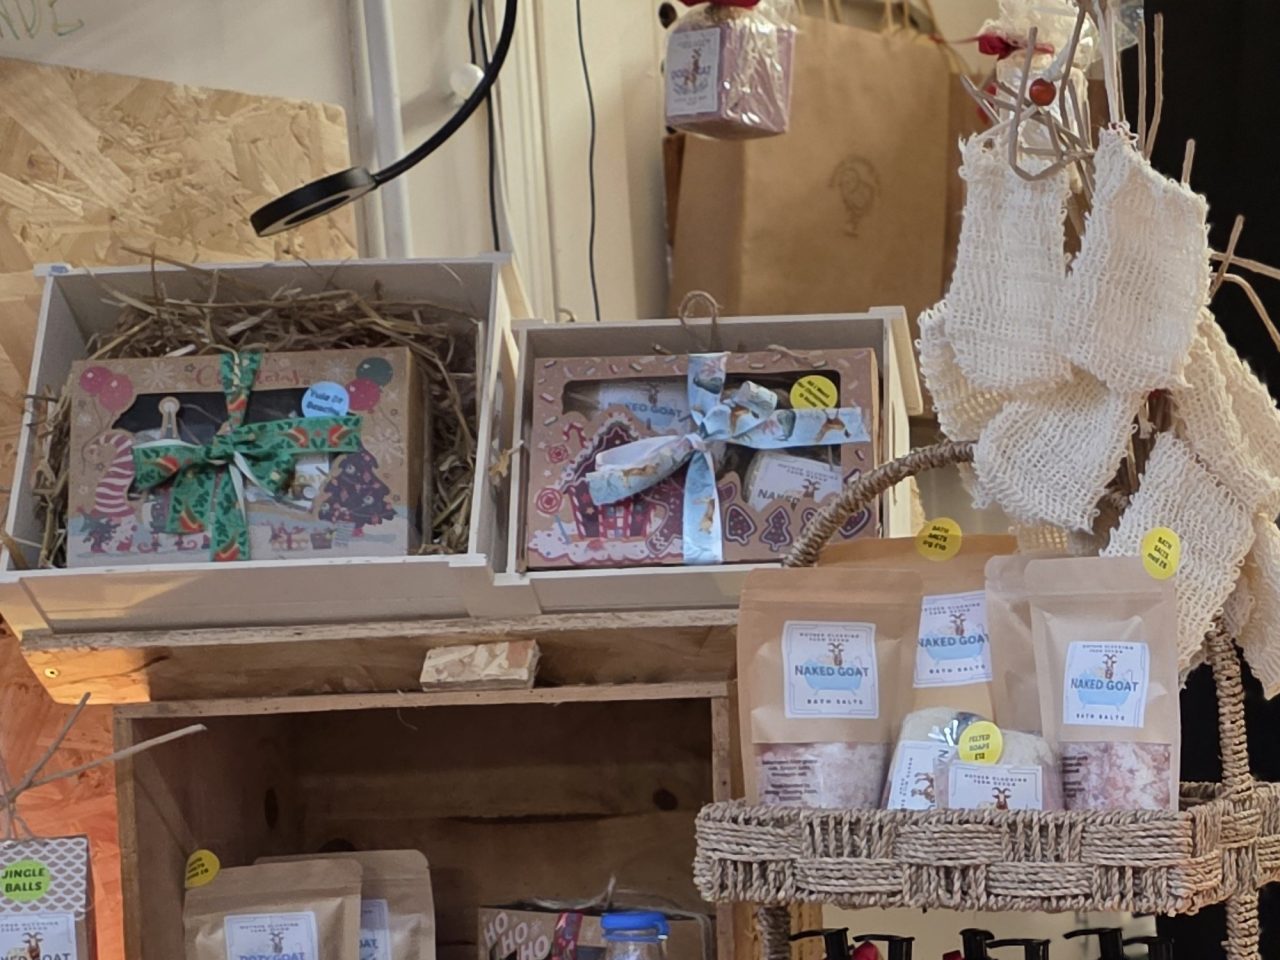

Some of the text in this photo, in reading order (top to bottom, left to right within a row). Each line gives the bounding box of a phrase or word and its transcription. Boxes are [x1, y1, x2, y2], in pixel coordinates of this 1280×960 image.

[918, 636, 956, 648] NAKED
[794, 665, 869, 677] NAKED GOAT
[1070, 678, 1139, 692] NAKED GOAT
[2, 867, 45, 879] JINGLE
[5, 881, 42, 893] BALLS
[484, 912, 508, 947] HO
[501, 922, 528, 959] HO
